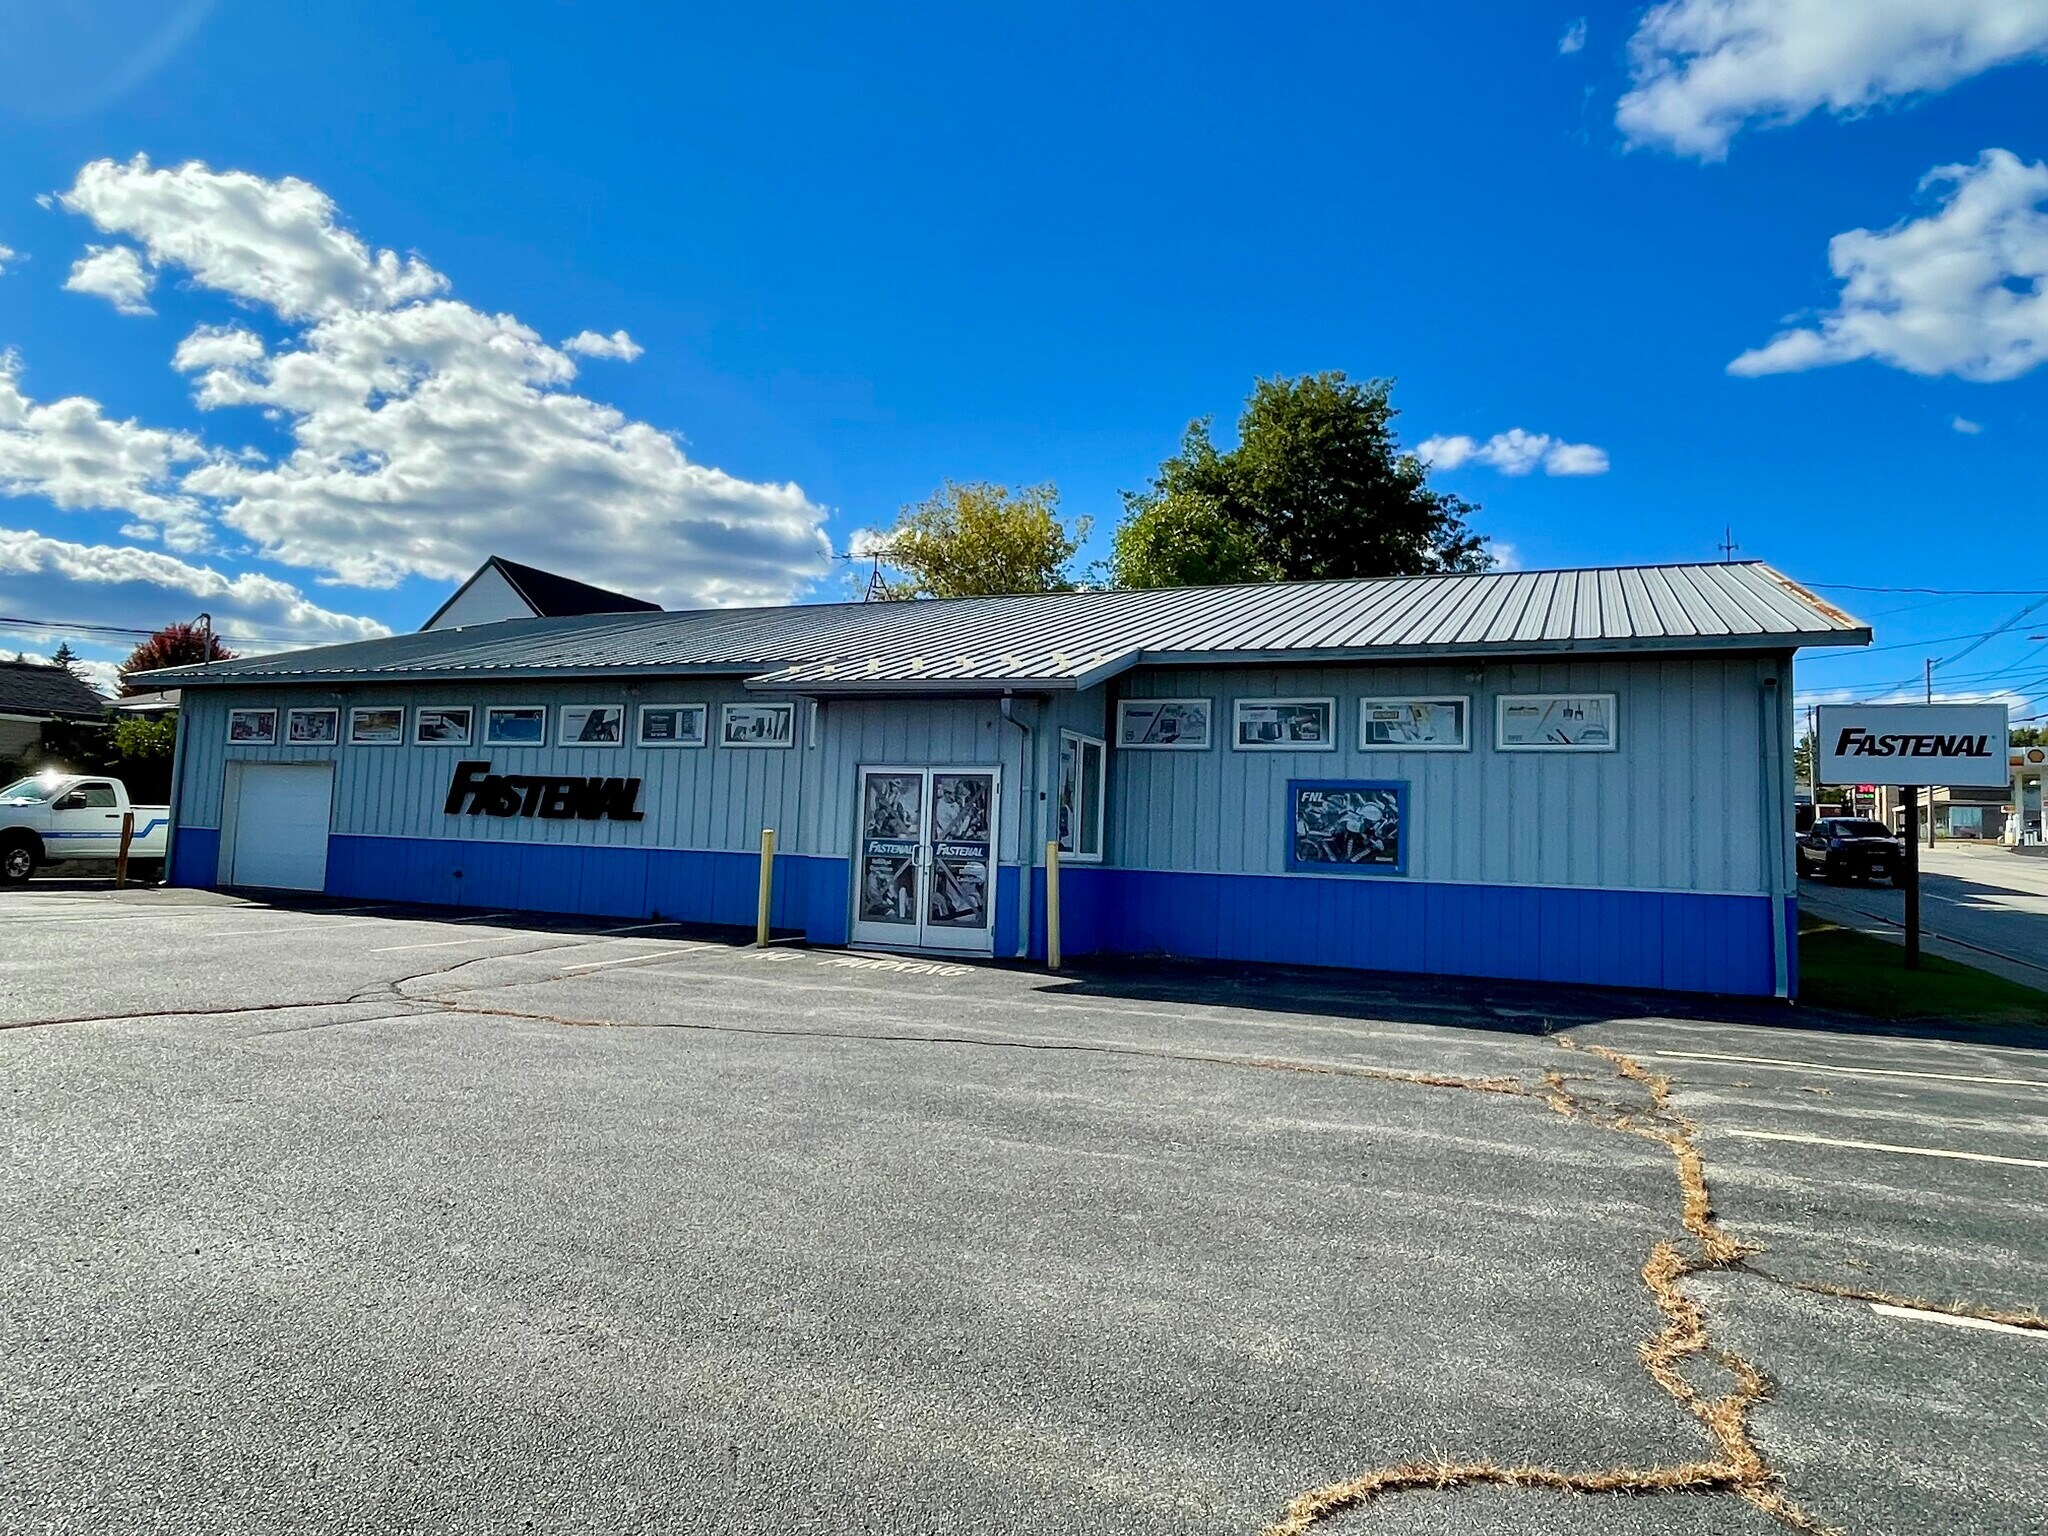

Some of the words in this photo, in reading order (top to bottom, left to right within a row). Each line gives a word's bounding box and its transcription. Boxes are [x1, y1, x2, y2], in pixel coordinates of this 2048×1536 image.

[1835, 727, 1993, 757] FASTENAL
[444, 760, 646, 822] FASTENAL
[1301, 791, 1325, 802] FNL
[868, 841, 914, 855] FASTENAL
[936, 843, 984, 857] FASTENAL
[817, 957, 976, 977] PARKING
